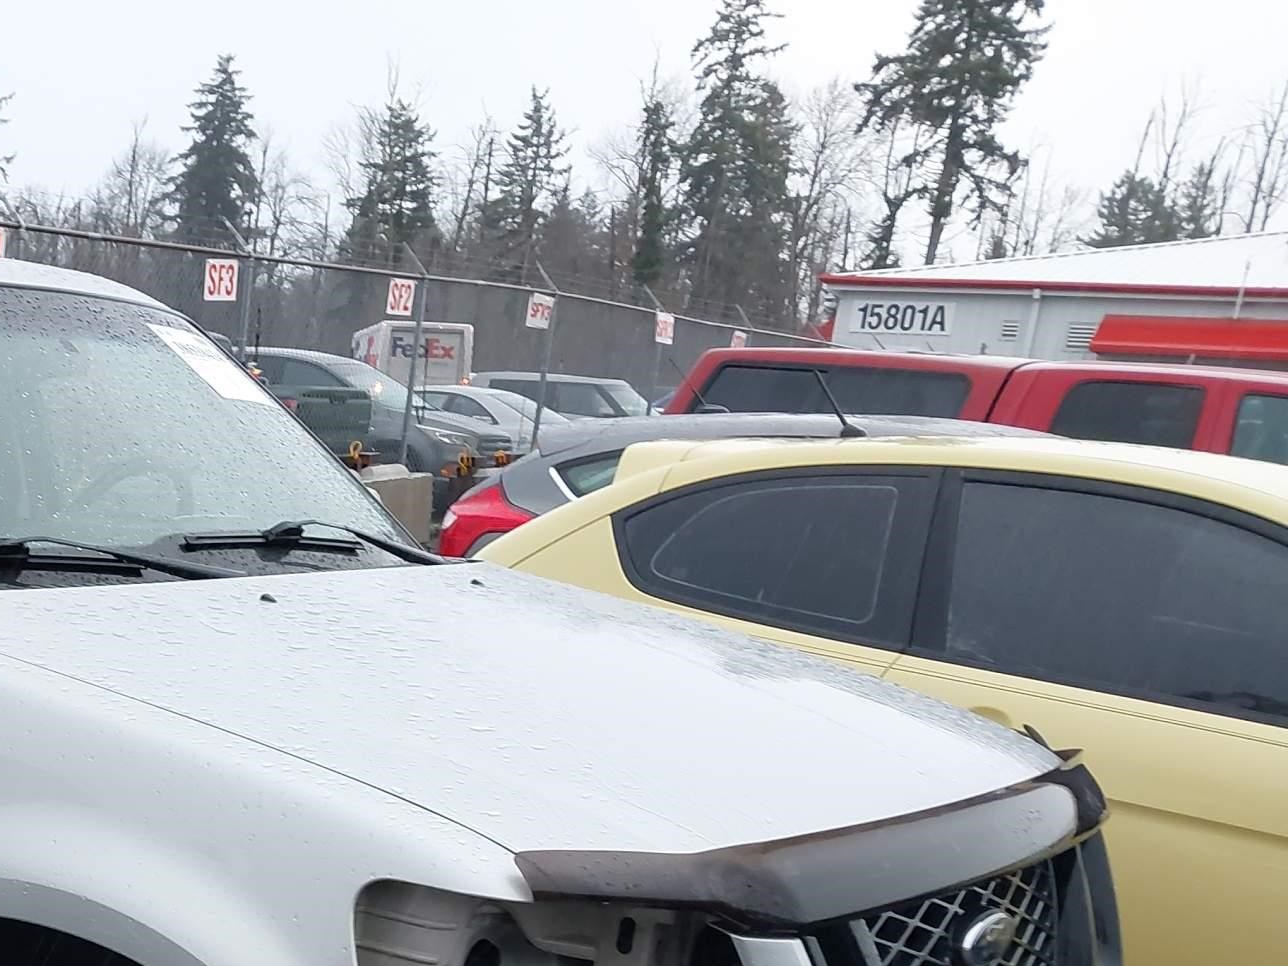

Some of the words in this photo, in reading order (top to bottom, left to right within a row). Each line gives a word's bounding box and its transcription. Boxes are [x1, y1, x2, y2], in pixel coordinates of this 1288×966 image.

[208, 263, 235, 296] SF3
[389, 282, 412, 312] SF2
[857, 303, 947, 332] 15801A
[392, 336, 455, 360] FedEx
